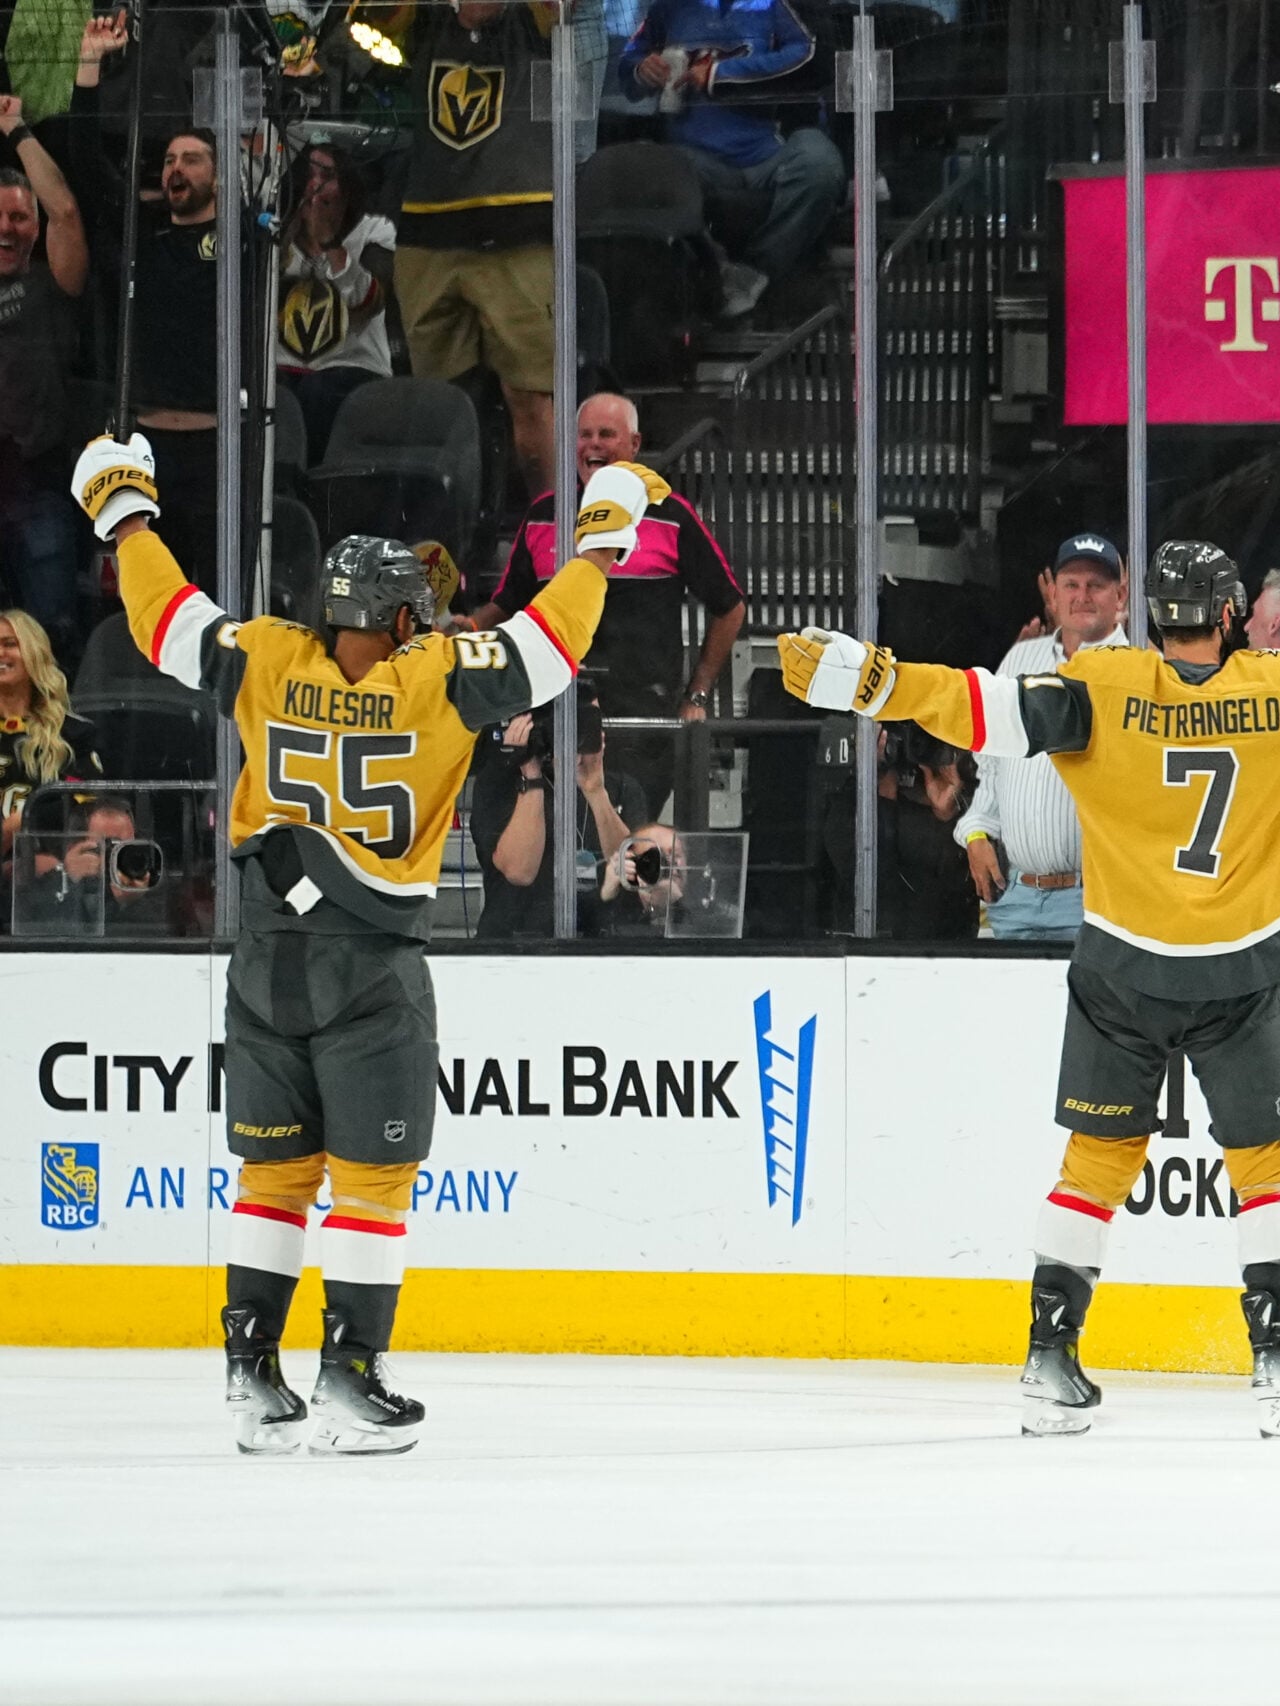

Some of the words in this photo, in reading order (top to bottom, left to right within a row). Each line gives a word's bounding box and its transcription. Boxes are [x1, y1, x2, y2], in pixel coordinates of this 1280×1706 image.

[332, 576, 351, 597] 55
[1168, 603, 1179, 620] 7
[284, 679, 394, 730] KOLESAR
[1123, 696, 1280, 739] PIETRANGELO
[265, 720, 416, 861] 55
[1162, 746, 1240, 880] 7
[38, 1041, 194, 1113] CITY
[563, 1045, 741, 1119] BANK
[1064, 1097, 1134, 1116] BAUER
[126, 1166, 184, 1209] AN
[1124, 1156, 1243, 1219] OCK
[47, 1205, 95, 1225] RBC
